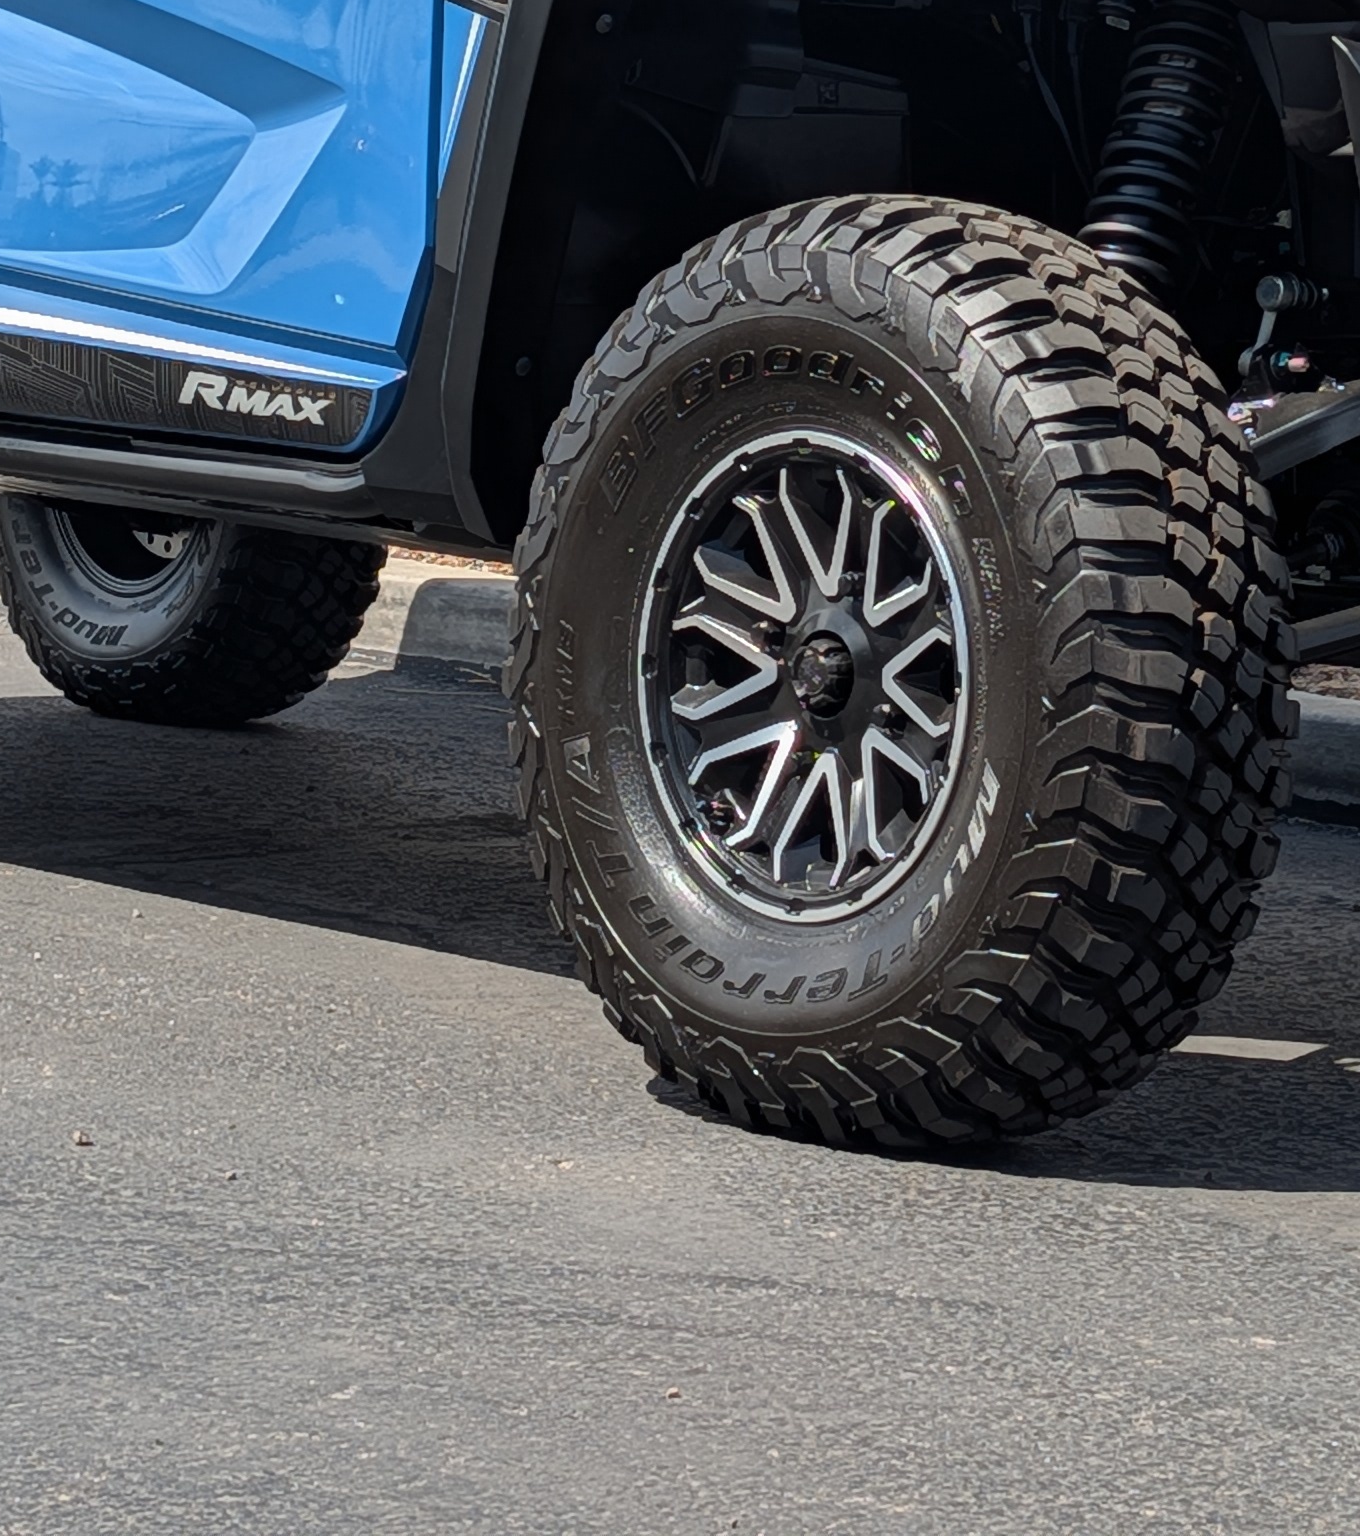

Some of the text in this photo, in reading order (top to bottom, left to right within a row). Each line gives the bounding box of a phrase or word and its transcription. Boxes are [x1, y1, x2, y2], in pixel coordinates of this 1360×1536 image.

[177, 370, 336, 427] RMAX
[599, 343, 974, 517] BFGoodrich
[560, 731, 635, 889] T/A
[627, 757, 1001, 1005] Mud-Terrain
